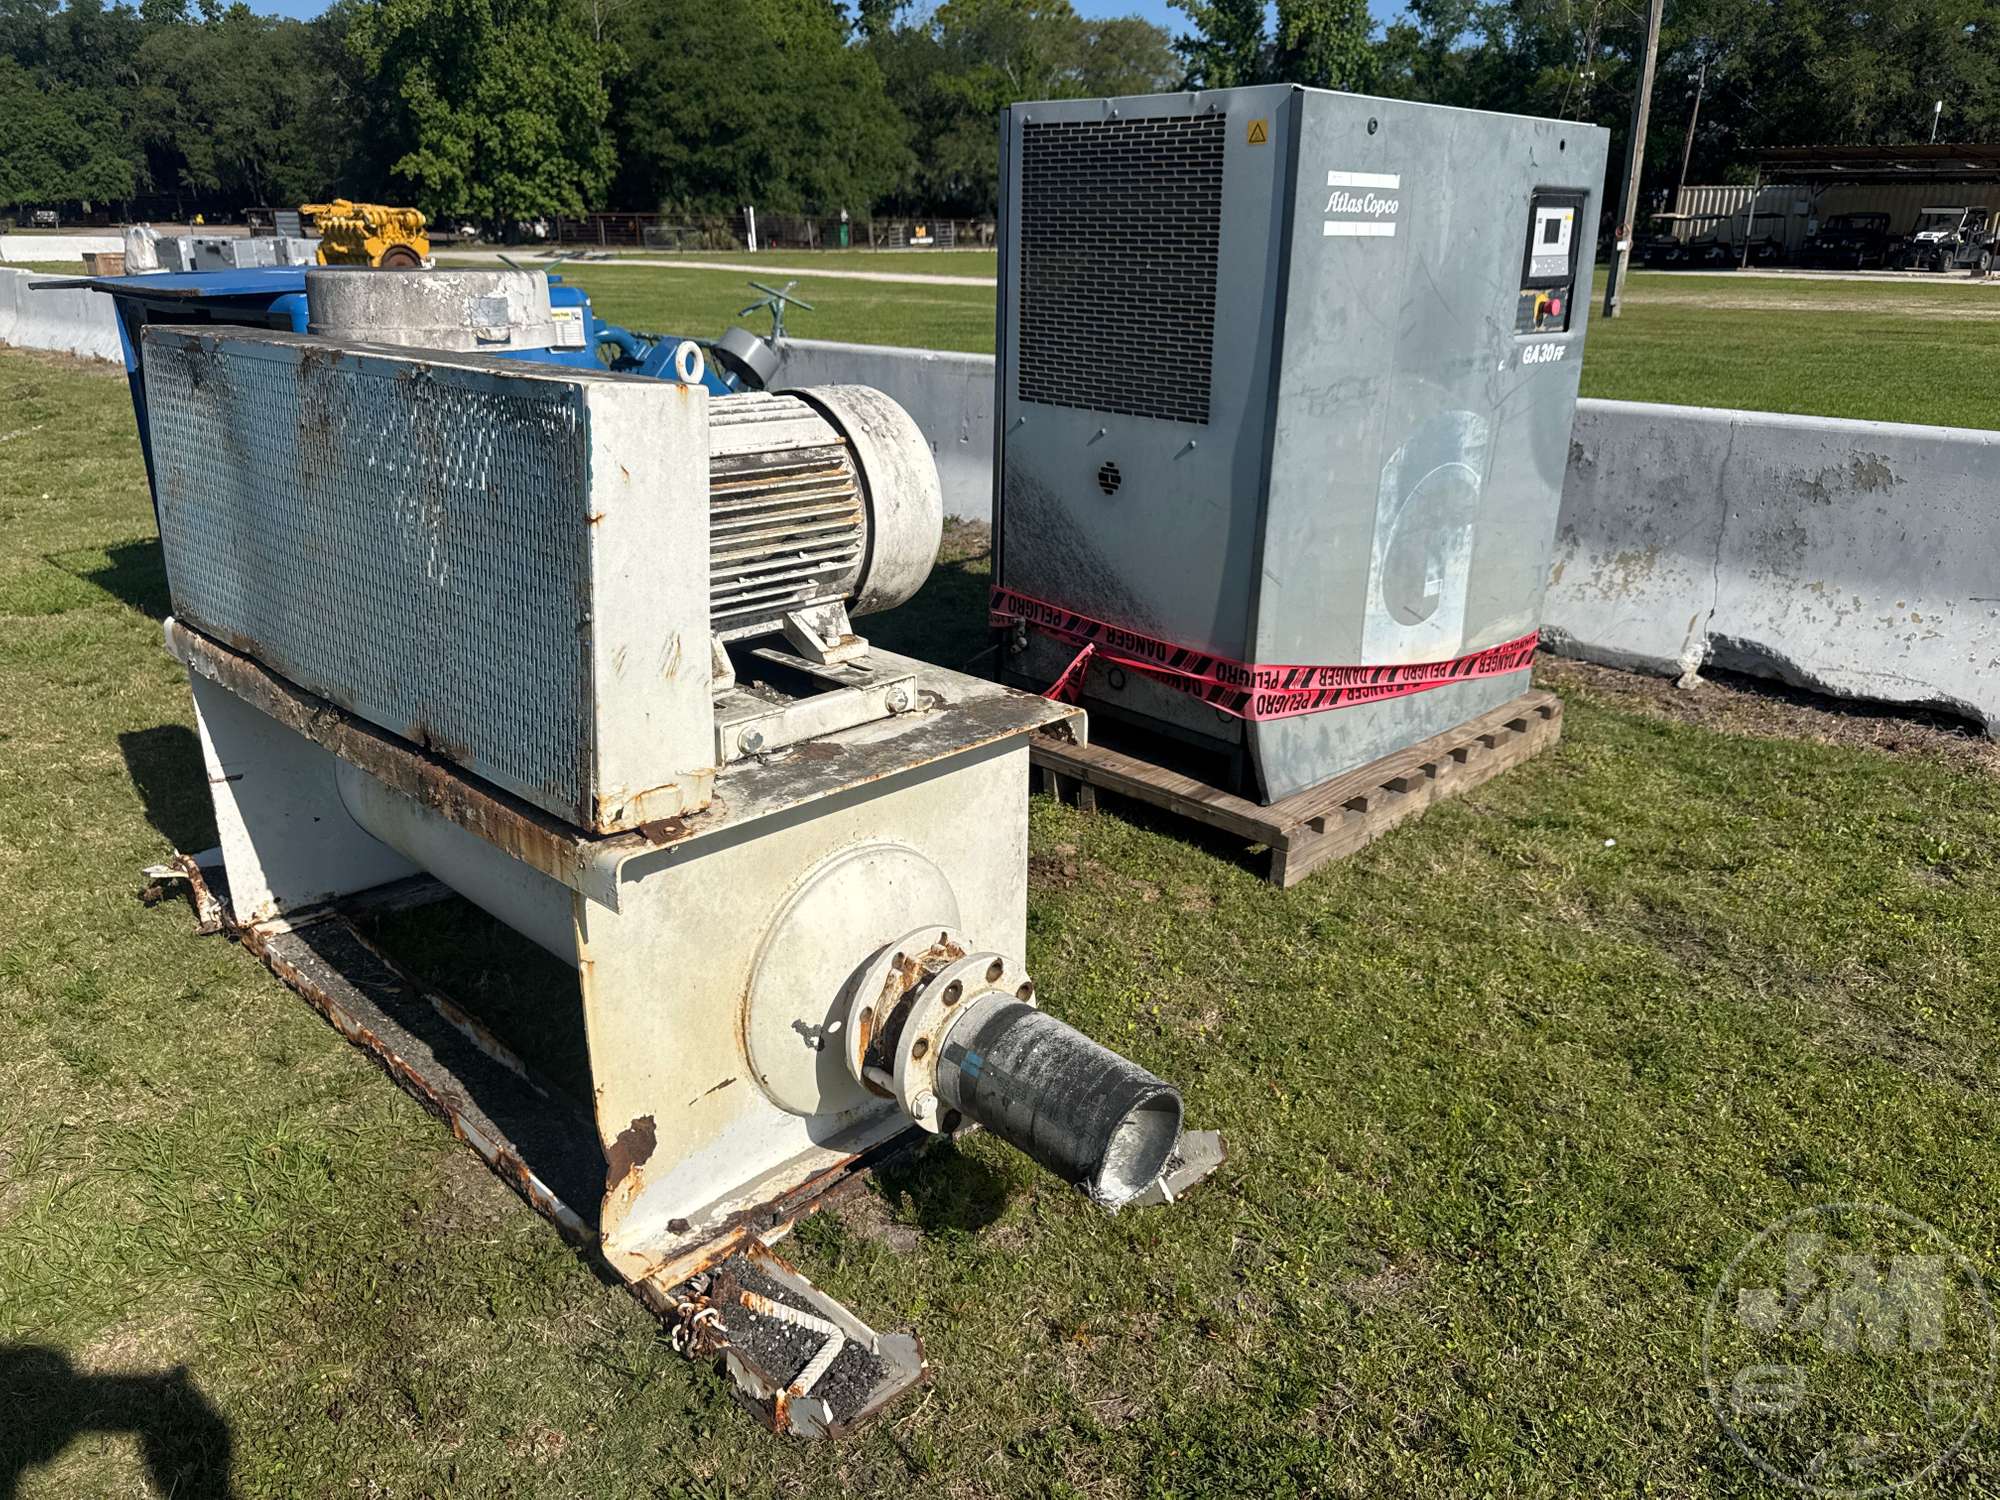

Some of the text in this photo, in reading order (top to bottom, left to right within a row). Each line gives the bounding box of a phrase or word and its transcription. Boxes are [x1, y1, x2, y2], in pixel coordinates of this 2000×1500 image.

[1324, 191, 1399, 218] Atlas Copco
[1007, 595, 1062, 627] PELIGRO
[1106, 627, 1167, 662] DANGER
[1402, 664, 1447, 682] PELIGRO
[1477, 652, 1517, 674] DANGER
[1216, 662, 1280, 690] PELIGRO
[1318, 667, 1369, 687] DANGER
[1256, 692, 1311, 716] PELIGRO
